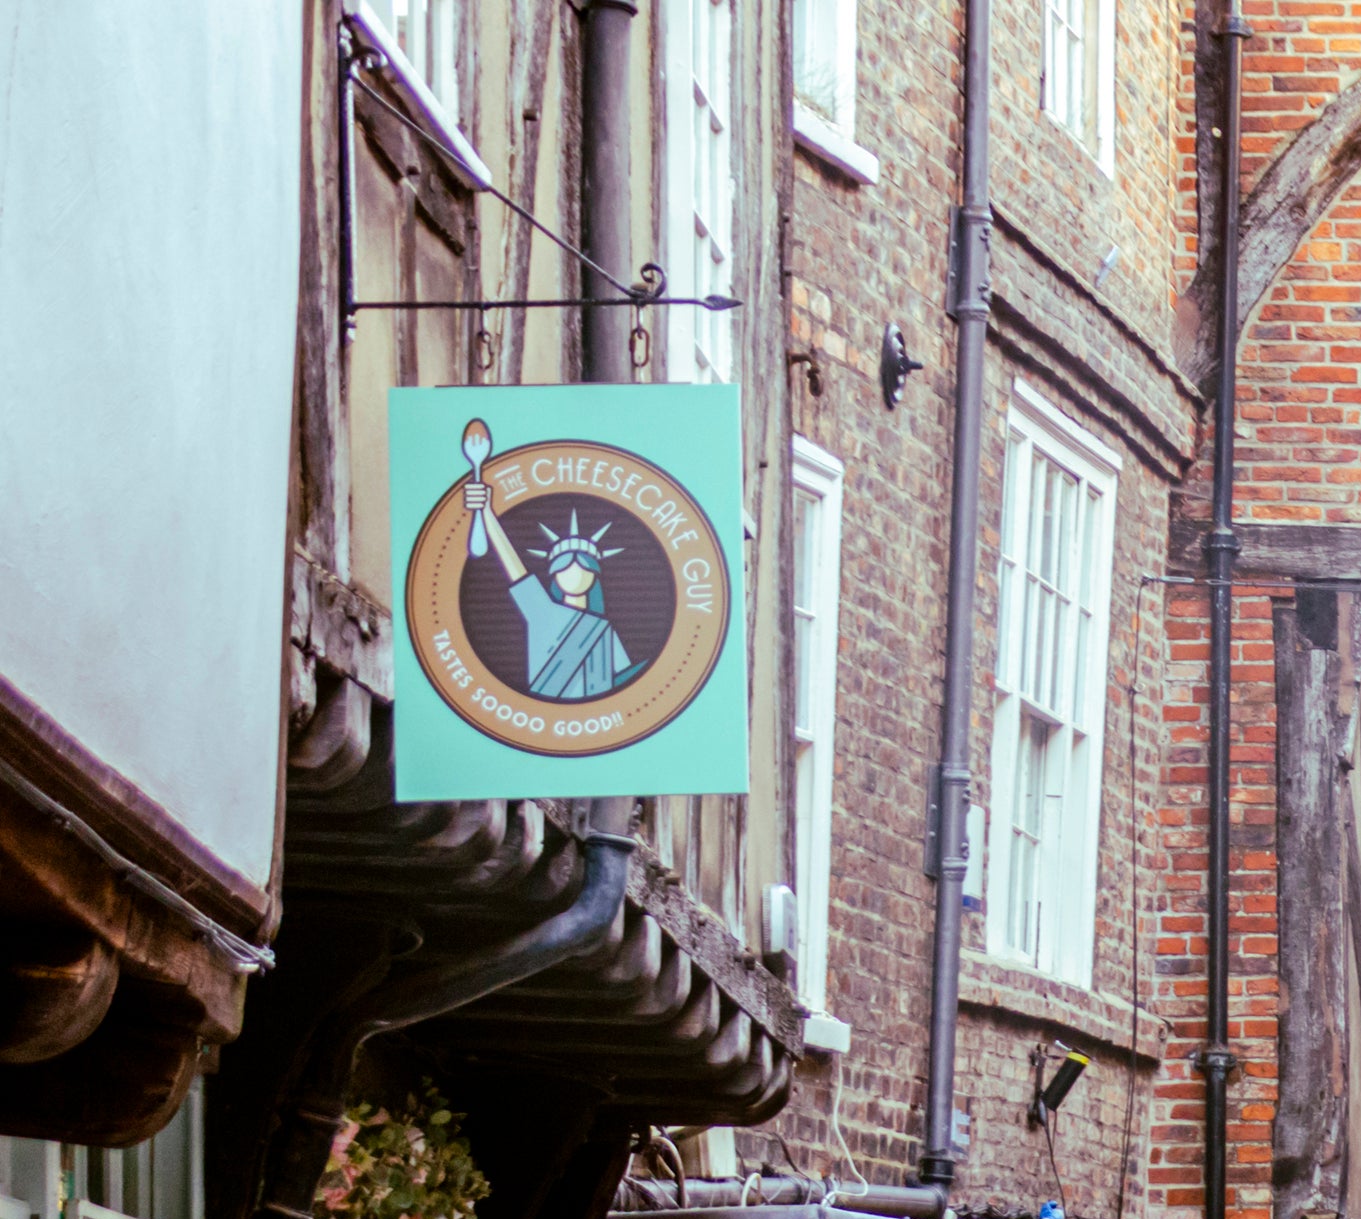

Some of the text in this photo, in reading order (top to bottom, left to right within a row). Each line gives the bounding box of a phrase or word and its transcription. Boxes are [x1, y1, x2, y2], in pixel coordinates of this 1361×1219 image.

[499, 457, 714, 614] THE CHEESECAKE GUY
[432, 629, 625, 737] TASTES SOOOO GOOD!!
